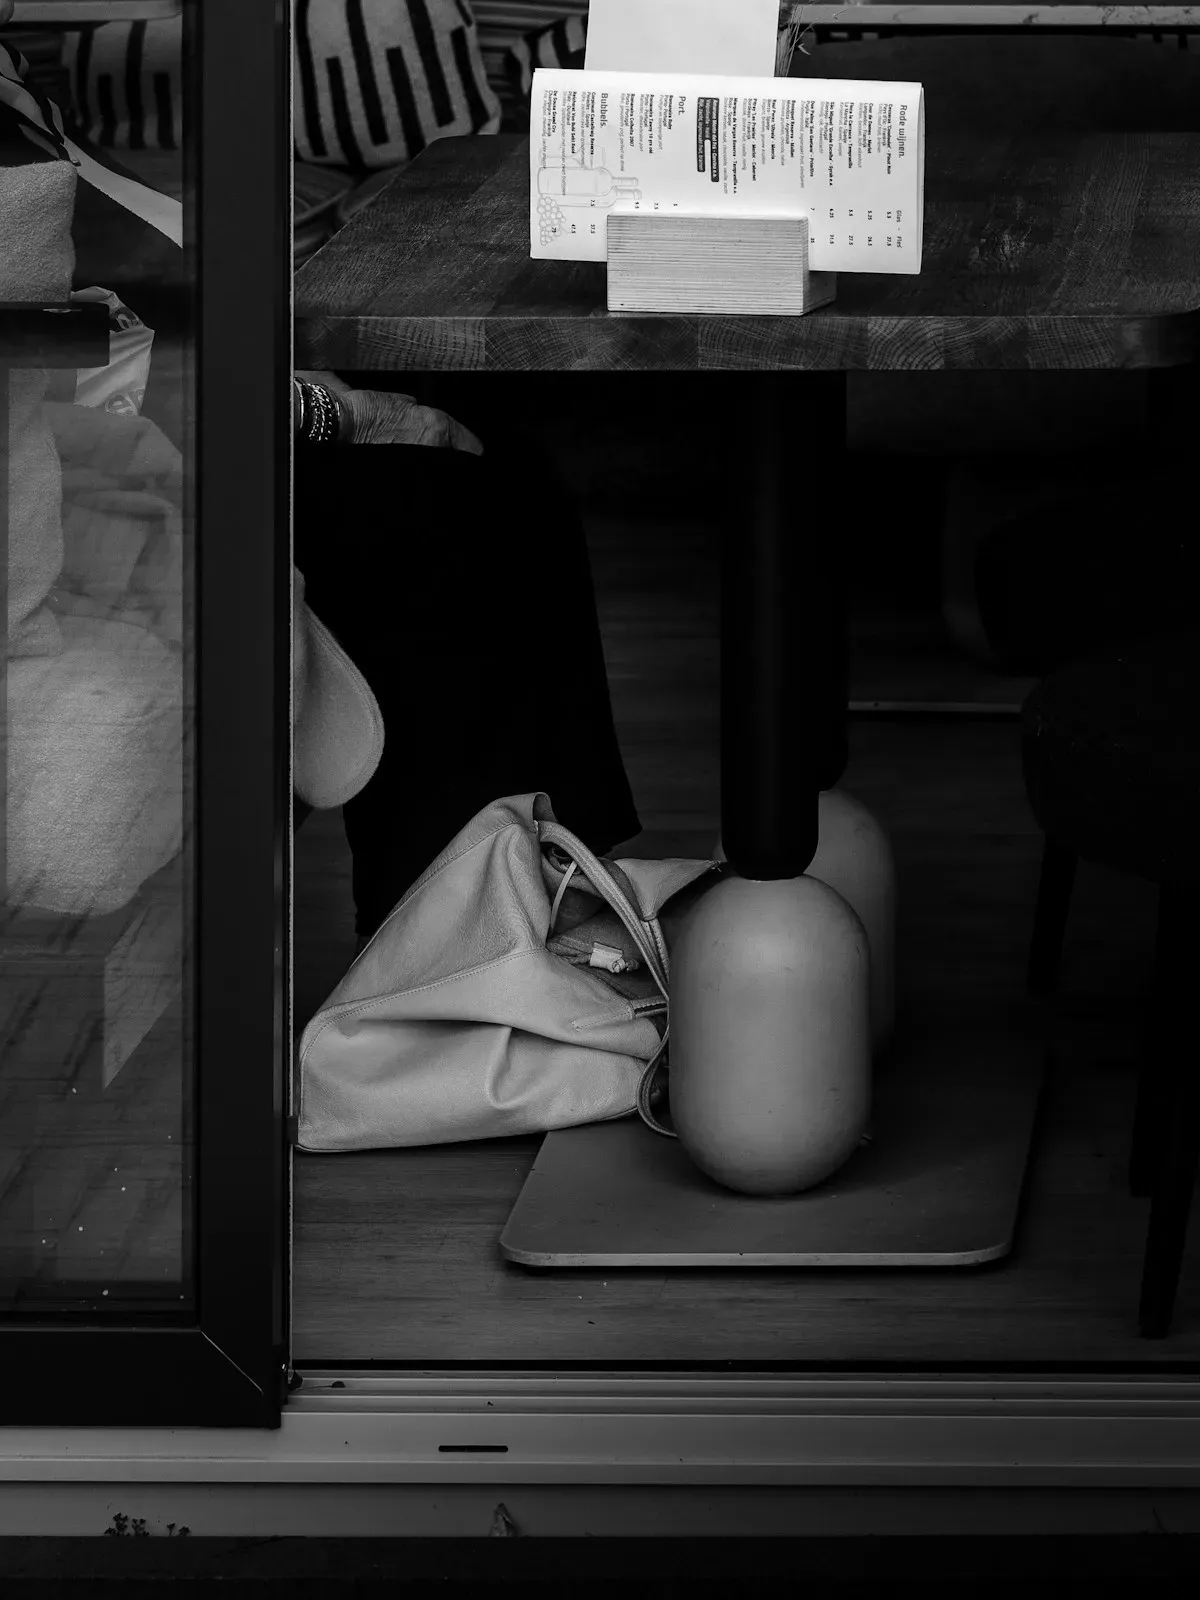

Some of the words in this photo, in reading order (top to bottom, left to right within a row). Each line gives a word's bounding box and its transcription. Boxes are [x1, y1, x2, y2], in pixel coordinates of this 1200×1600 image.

[600, 93, 608, 128] Bubbels.
[678, 96, 686, 115] Port.
[899, 105, 907, 126] Rode
[897, 129, 906, 158] wijnen.
